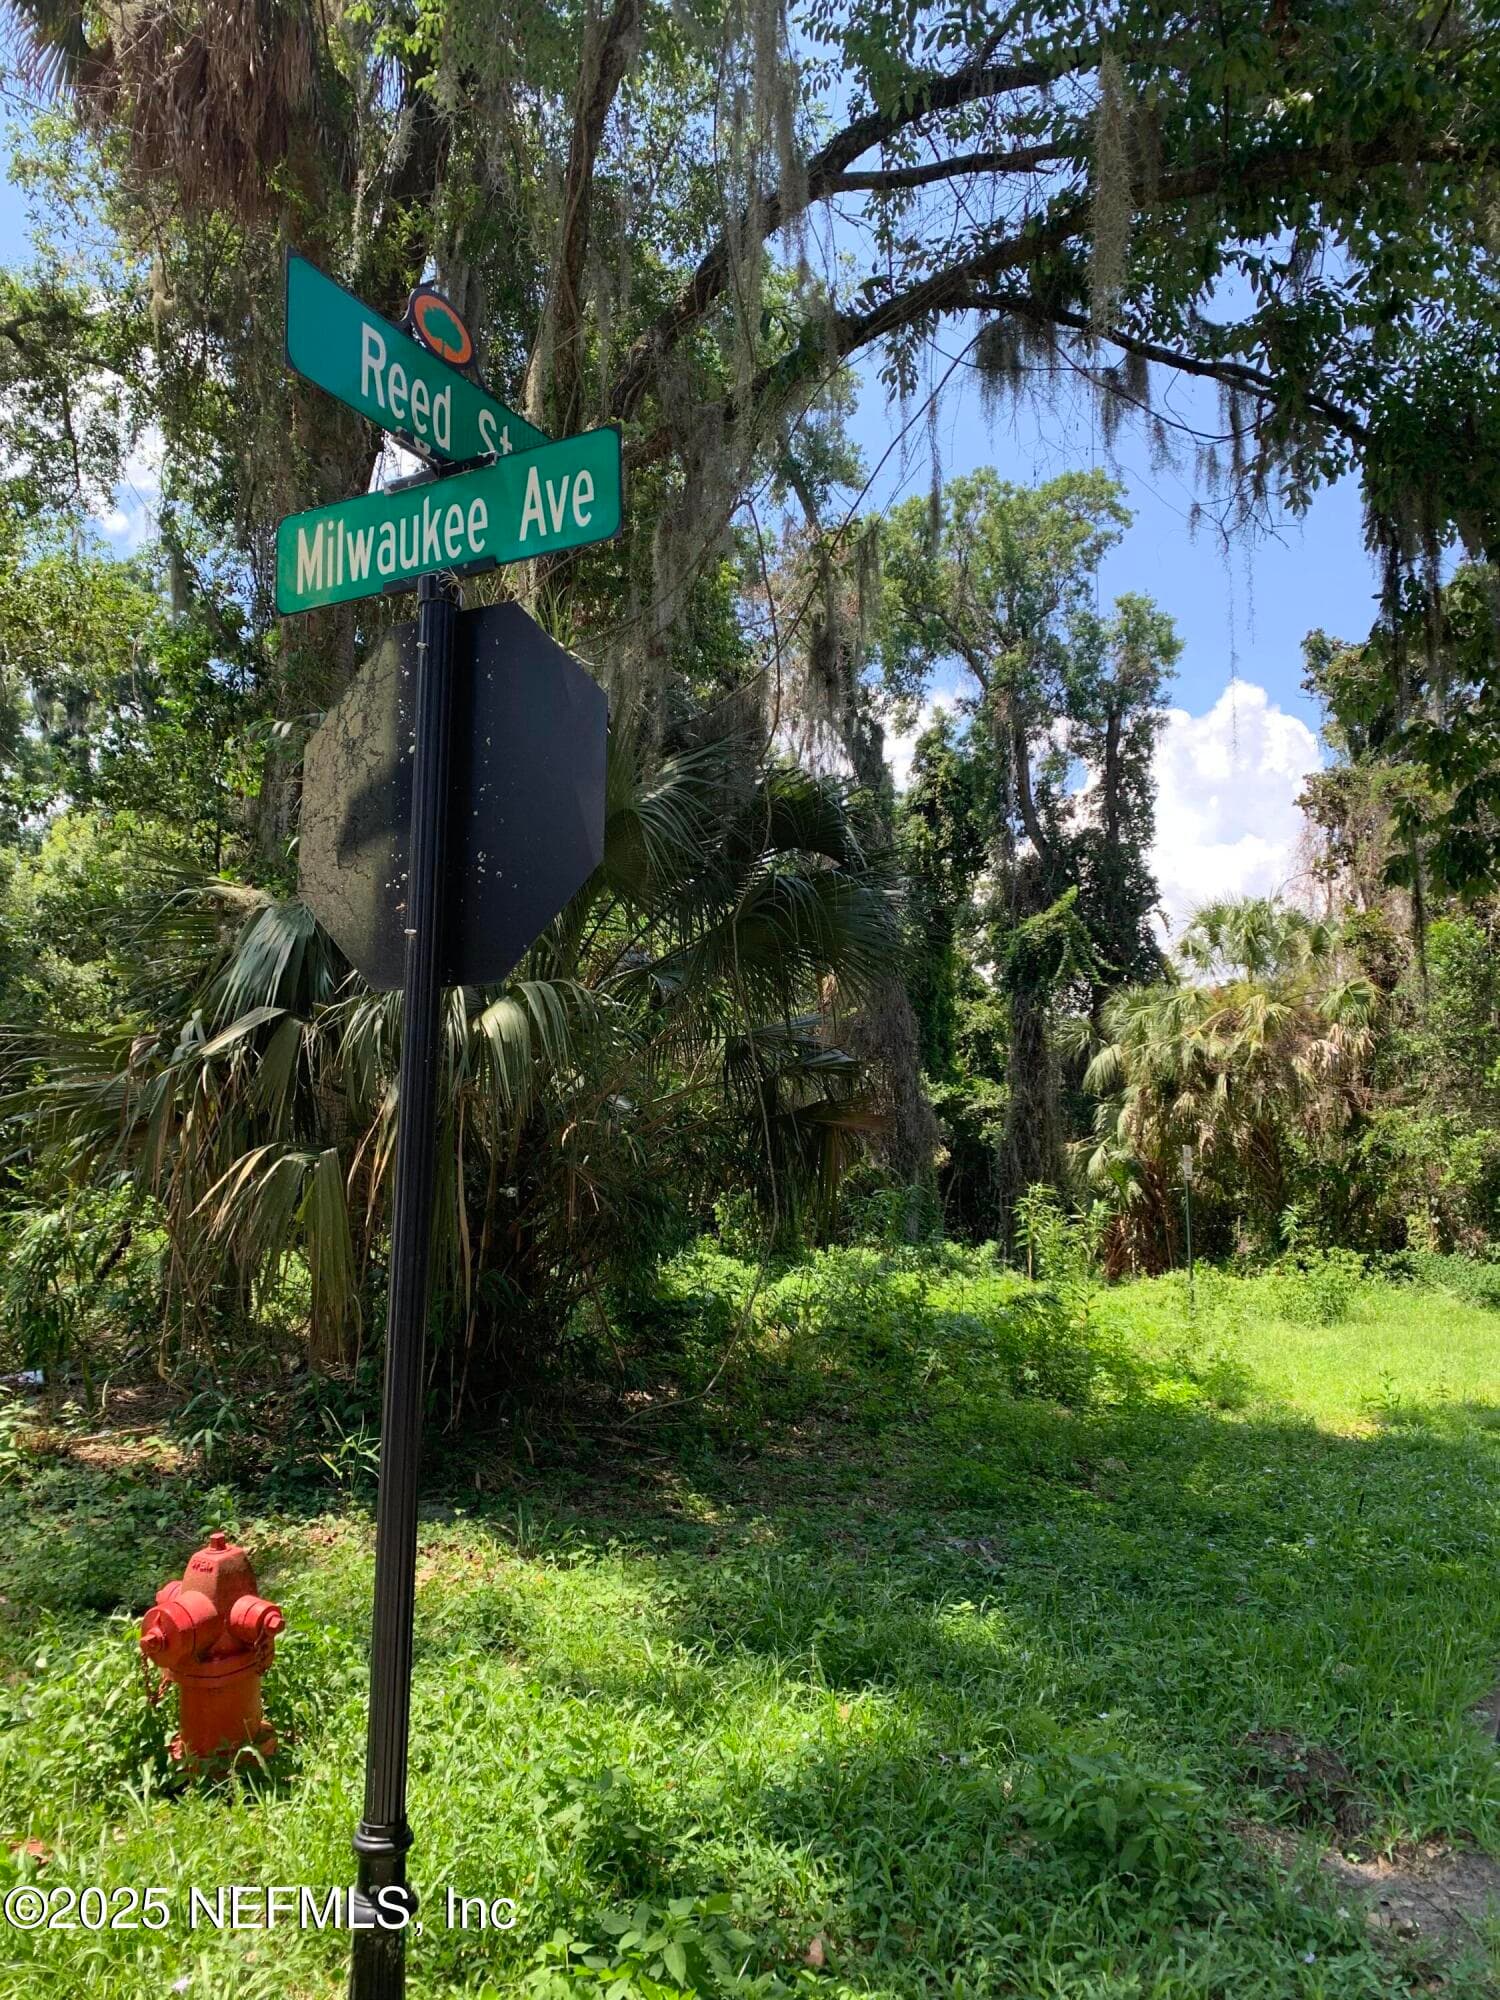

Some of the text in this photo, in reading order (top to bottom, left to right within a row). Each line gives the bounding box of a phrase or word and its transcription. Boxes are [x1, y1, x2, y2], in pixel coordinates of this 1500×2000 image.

[361, 322, 513, 456] Reed St
[296, 466, 595, 595] Milwaukee Ave
